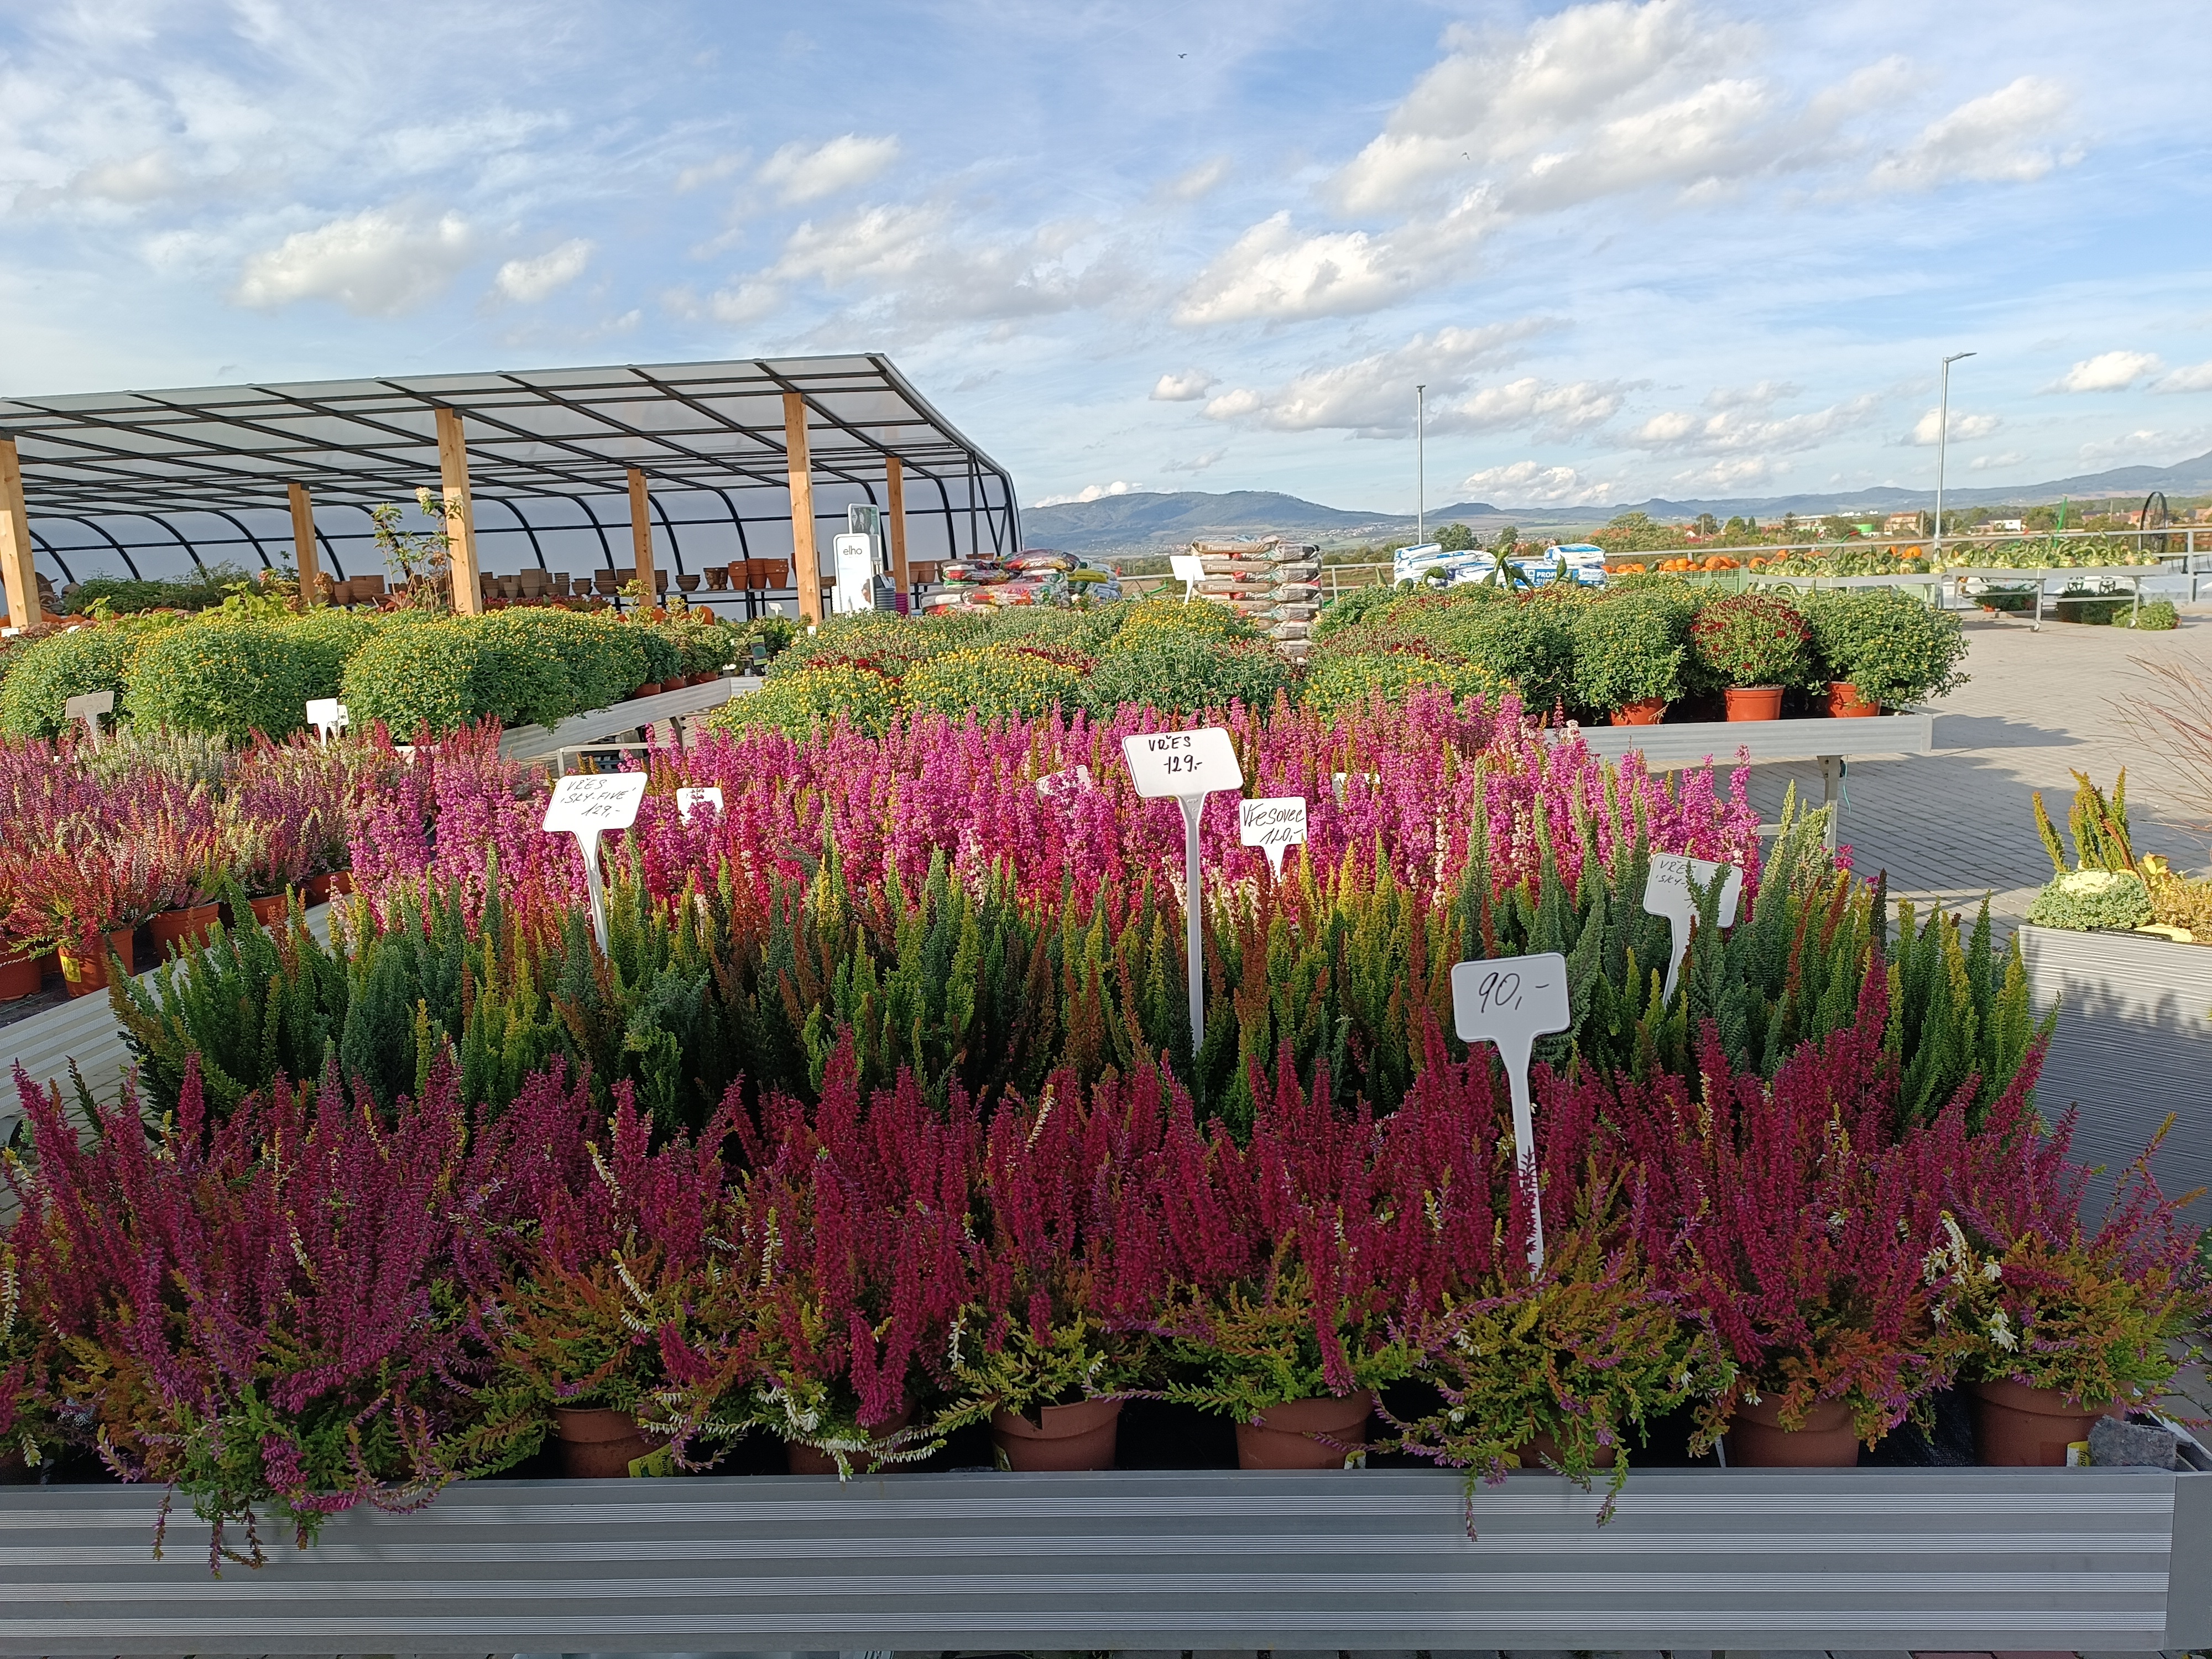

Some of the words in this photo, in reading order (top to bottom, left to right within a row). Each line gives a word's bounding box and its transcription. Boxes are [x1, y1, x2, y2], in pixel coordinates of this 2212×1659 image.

[843, 545, 862, 555] elho
[1149, 735, 1191, 752] VŘES
[1479, 972, 1550, 1013] 90,-
